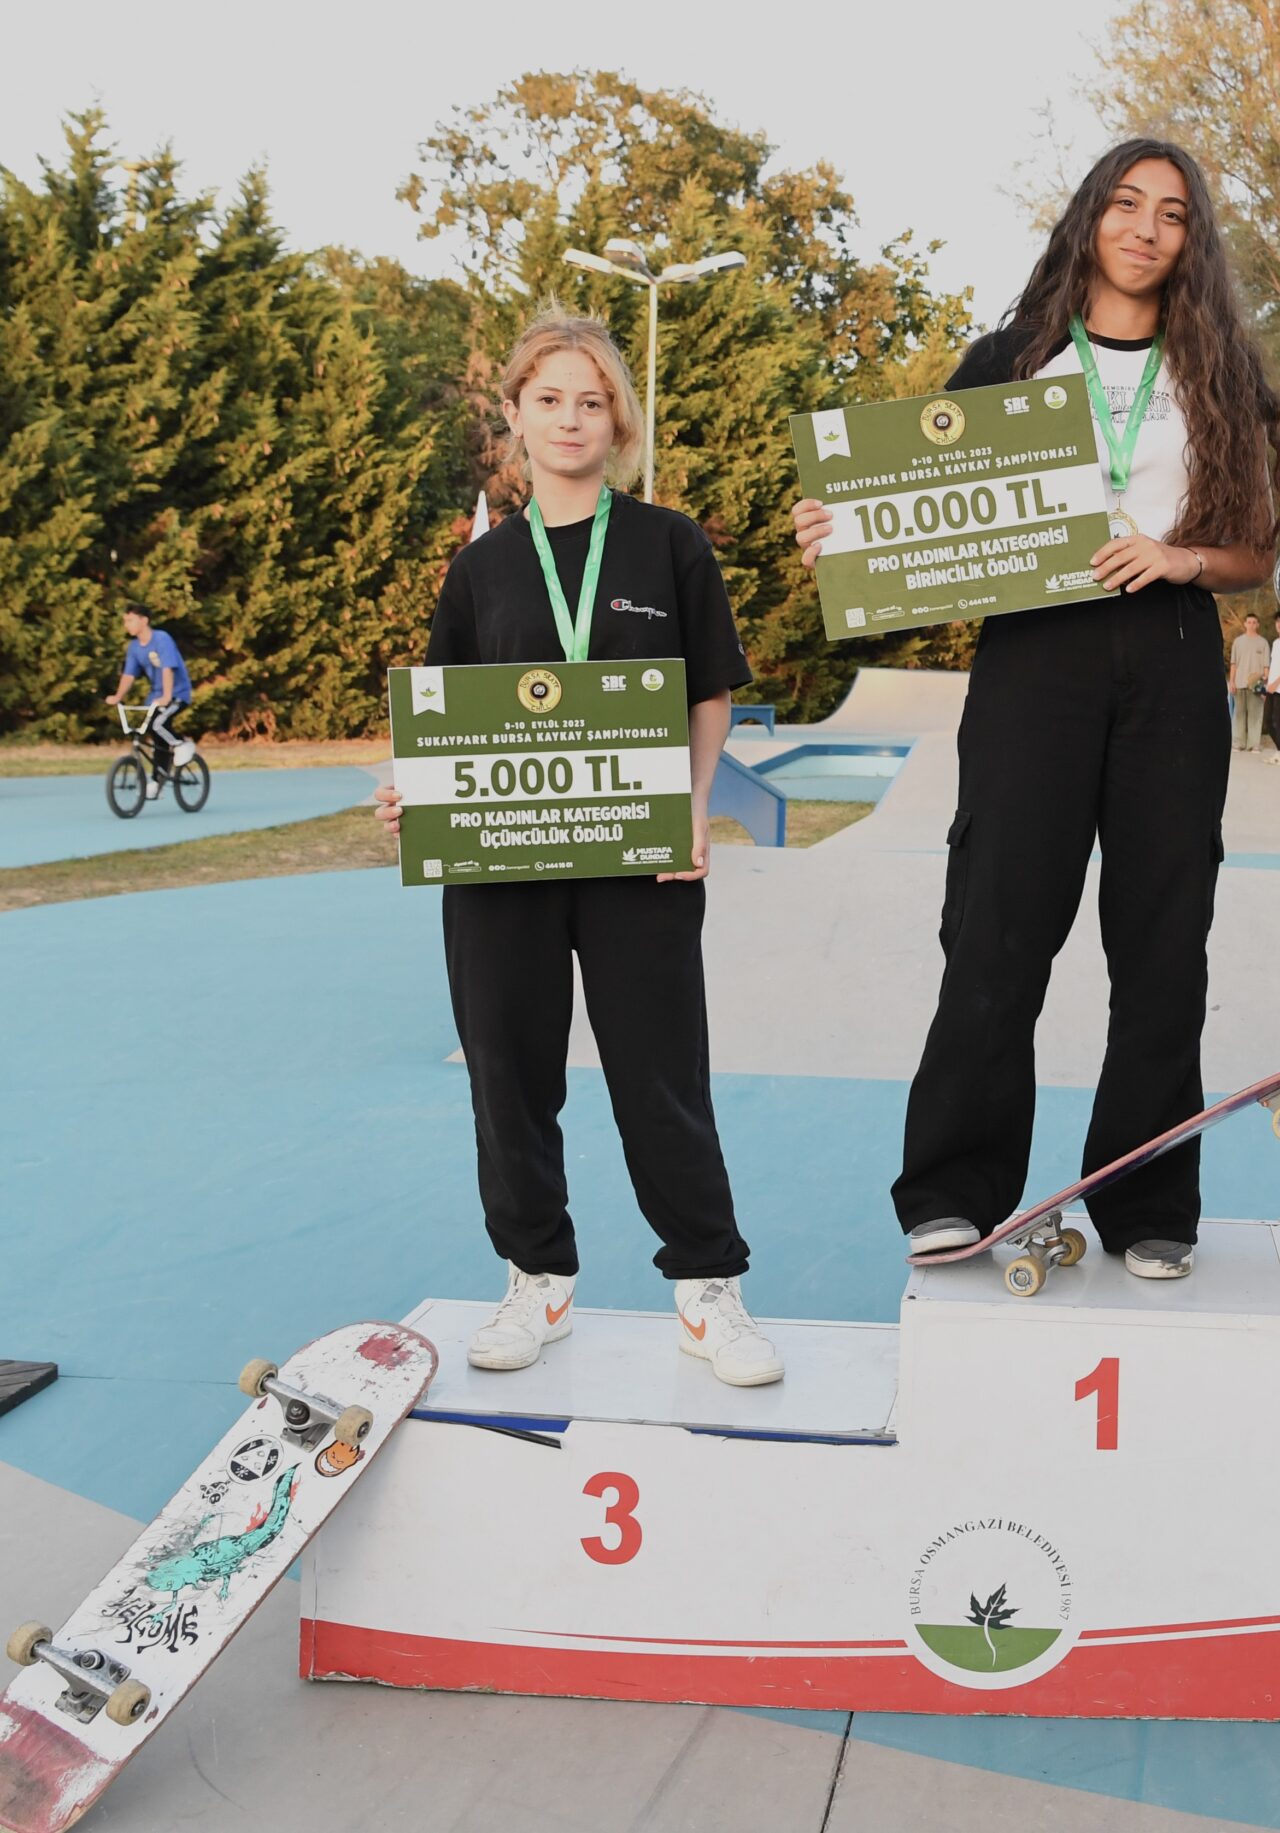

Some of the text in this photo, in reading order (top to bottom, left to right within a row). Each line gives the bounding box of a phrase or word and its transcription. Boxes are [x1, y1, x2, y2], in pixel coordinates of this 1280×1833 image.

[826, 446, 1077, 493] SUKAYPARK BURSA KAYKAY ŞAMPİYONASI
[912, 447, 992, 466] 9-10 EYLÜL 2023
[854, 479, 1067, 542] 10.000 TL.
[868, 526, 1068, 573] PRO KADINLAR KATEGORİSİ
[906, 552, 1037, 589] BİRİNCİLİK ÖDÜLÜ
[417, 728, 667, 747] SUKAYPARK BURSA KAYKAY ŞAMPİYONASI
[505, 722, 525, 730] 9-10
[532, 720, 559, 729] EYLÜL
[455, 755, 642, 798] 5.000 TL.
[451, 802, 649, 827] PRO KADINLAR KATEGORİSİ
[480, 824, 623, 849] ÜÇÜNCÜLÜK ÖDÜLÜ
[1075, 1357, 1120, 1450] 1
[580, 1471, 643, 1565] 3
[909, 1517, 1074, 1621] BURSA OSMANGAZİ BELEDİYESİ 1987
[101, 1585, 199, 1655] WELCOME
